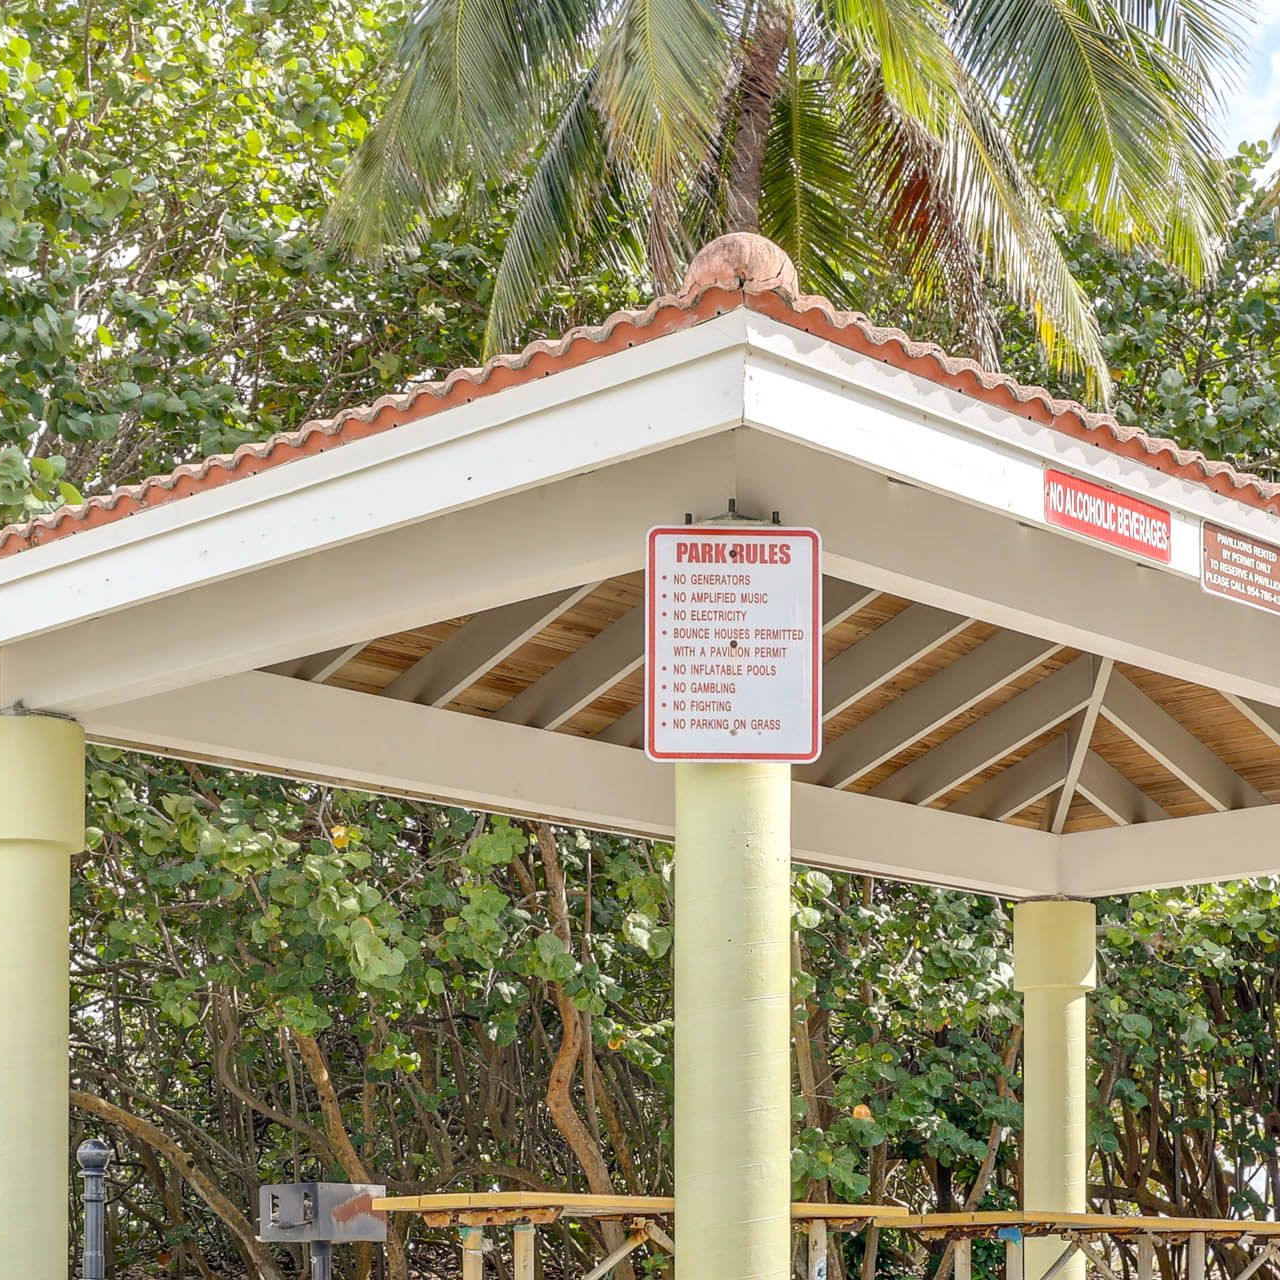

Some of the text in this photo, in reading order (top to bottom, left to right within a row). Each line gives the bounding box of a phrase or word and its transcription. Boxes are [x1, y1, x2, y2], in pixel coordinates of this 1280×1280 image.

[1049, 481, 1168, 551] NO ALCOHOLIC BEVERAGES
[676, 542, 791, 565] PARK RULES
[1217, 533, 1277, 562] PAVILLIONS RENTED
[1222, 549, 1272, 574] BY PERMIT ONLY
[1209, 558, 1219, 570] TO
[1219, 562, 1248, 580] RESERVE
[673, 574, 751, 586] NO GENERATORS
[1205, 571, 1230, 588] PLEASE
[1231, 579, 1246, 594] CALL
[673, 592, 768, 604] NO AMPLIFIED MUSIC
[673, 610, 747, 622] NO ELECTRICITY
[673, 628, 804, 640] BOUNCE HOUSES PERMITTED
[673, 646, 787, 658] WITH A PAVILION PERMIT
[673, 664, 777, 676] NO INFLATABLE POOLS
[673, 682, 736, 693] NO GAMBLING
[673, 700, 732, 712] NO FIGHTING
[673, 719, 781, 730] NO PARKING ON GRASS
